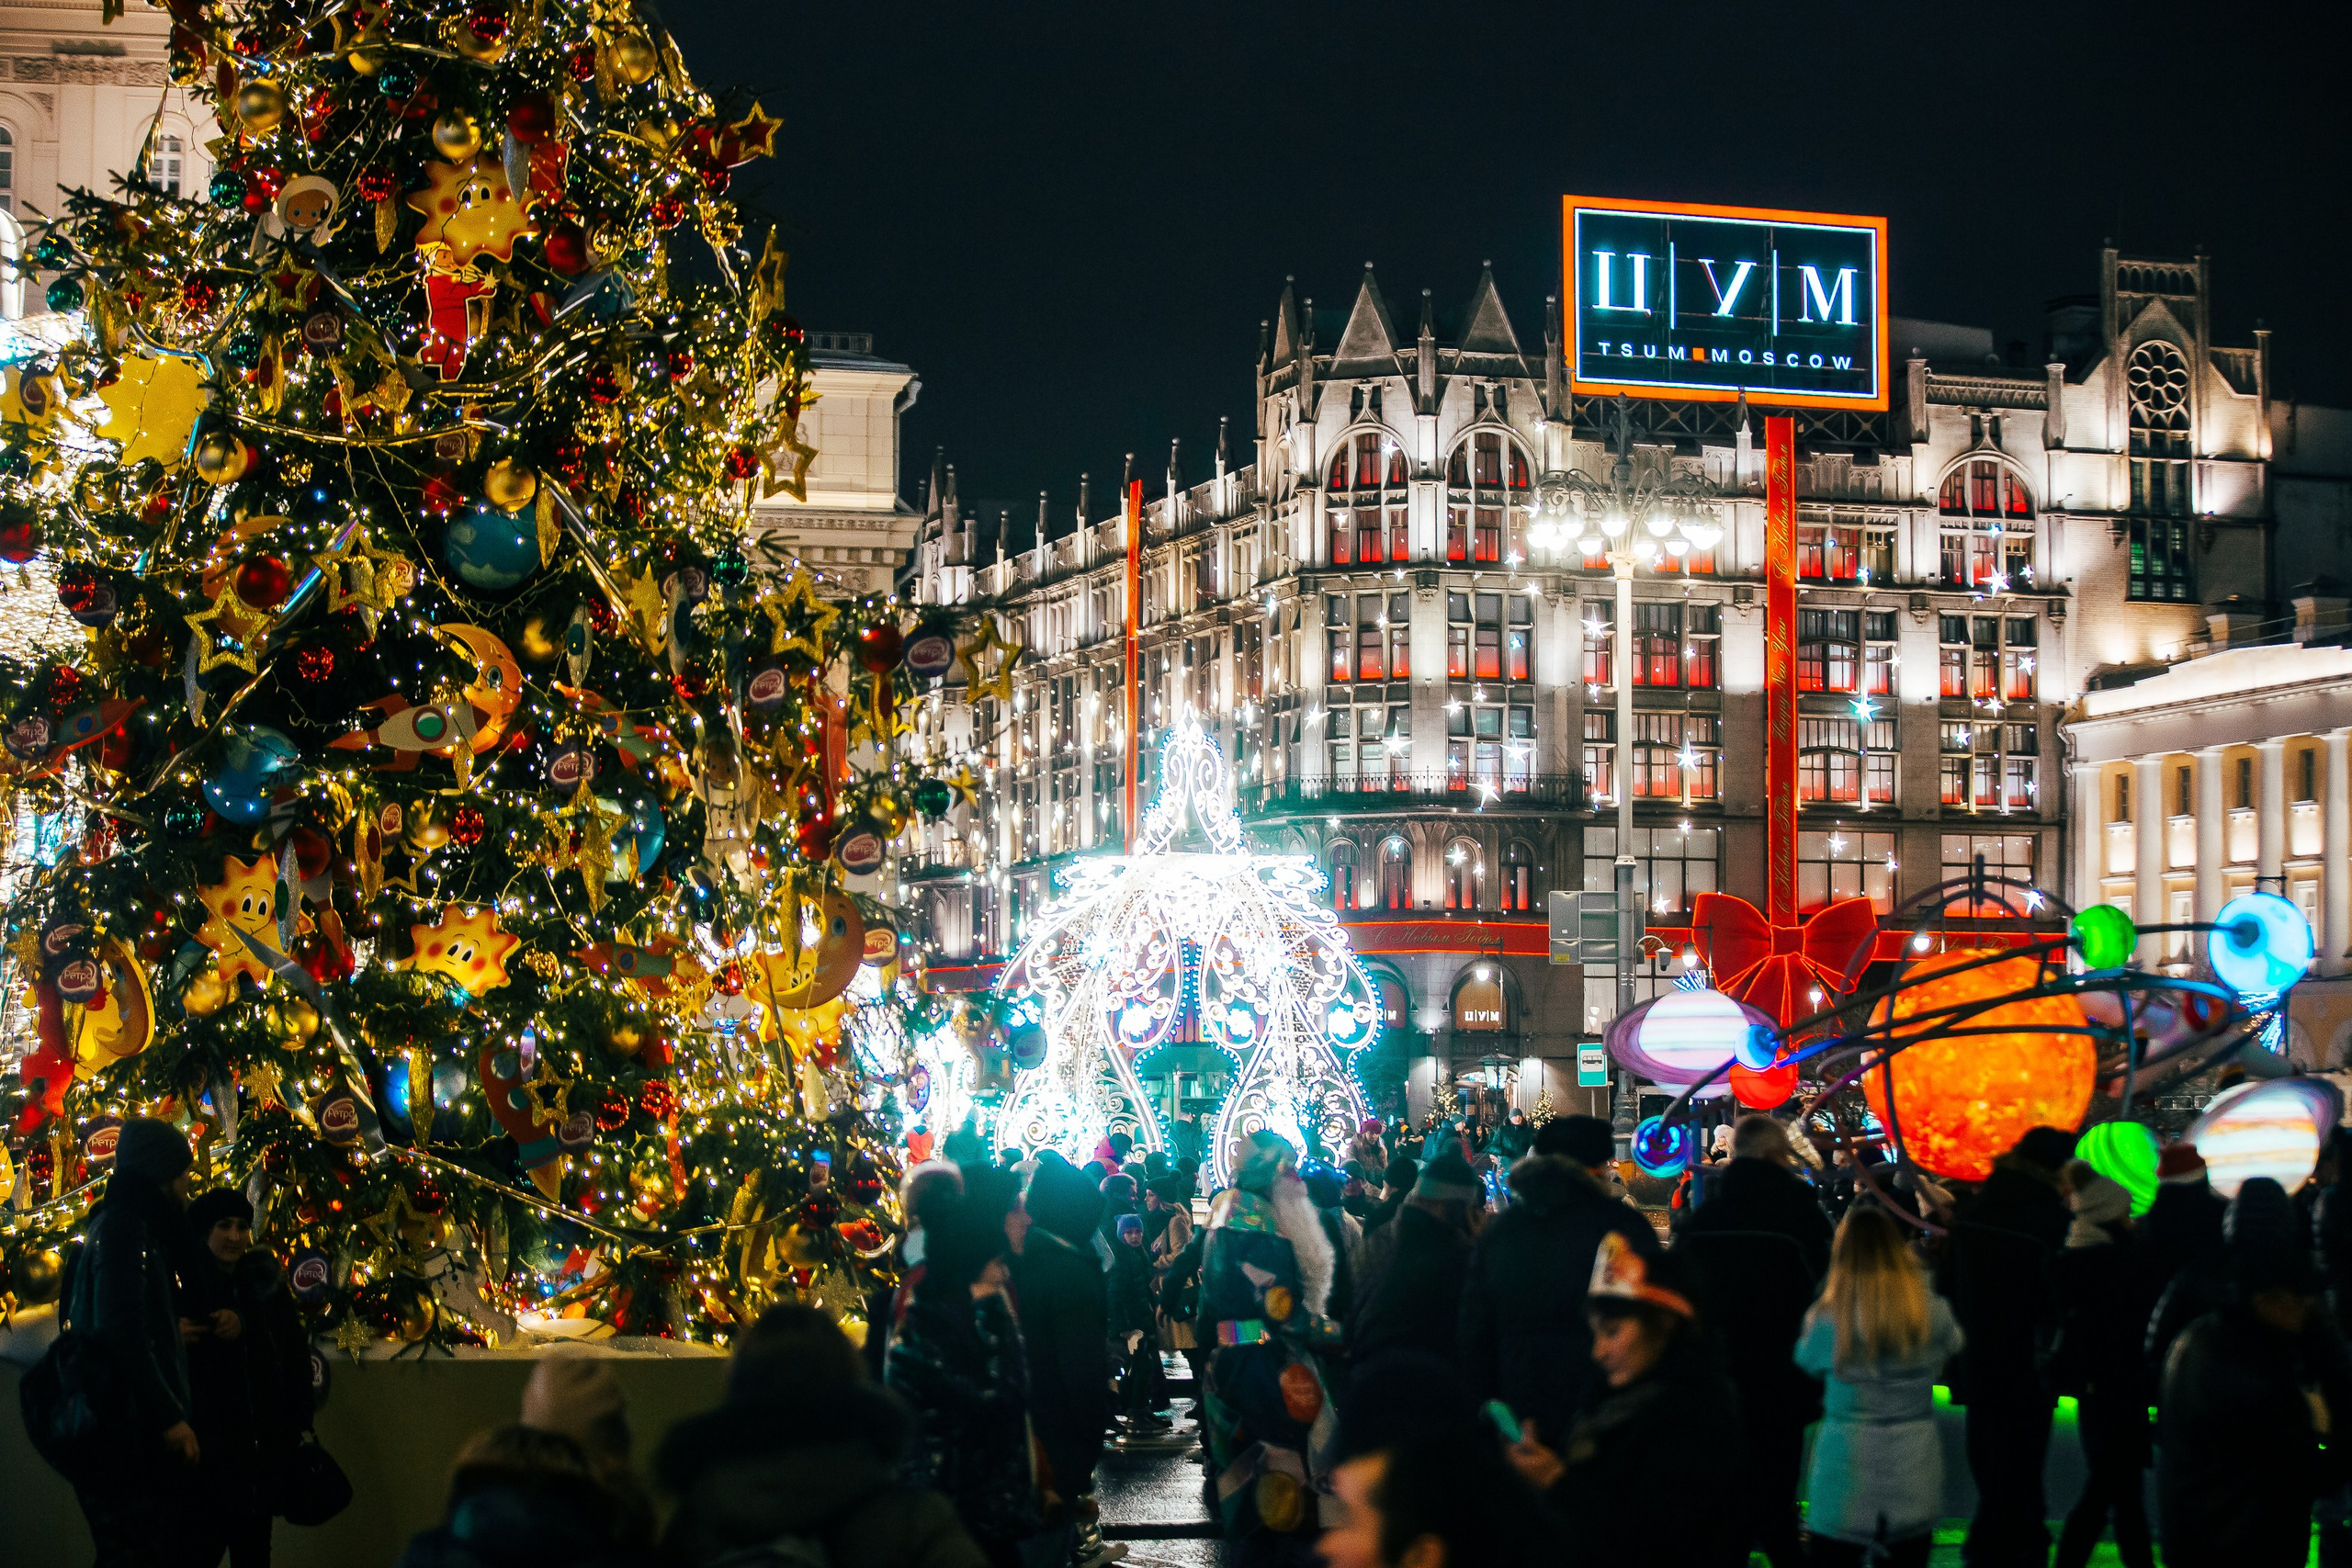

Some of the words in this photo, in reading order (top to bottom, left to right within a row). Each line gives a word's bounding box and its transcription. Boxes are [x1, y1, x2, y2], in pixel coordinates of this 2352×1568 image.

[1598, 342, 1687, 361] TSUM
[1711, 348, 1854, 371] MOSCOW
[1771, 443, 1789, 494] Годом
[1771, 497, 1790, 559] Новым
[1770, 616, 1792, 657] Year
[1771, 659, 1787, 694] New
[1771, 694, 1792, 745] Happy
[865, 938, 890, 949] етро
[91, 1136, 119, 1149] Ретр
